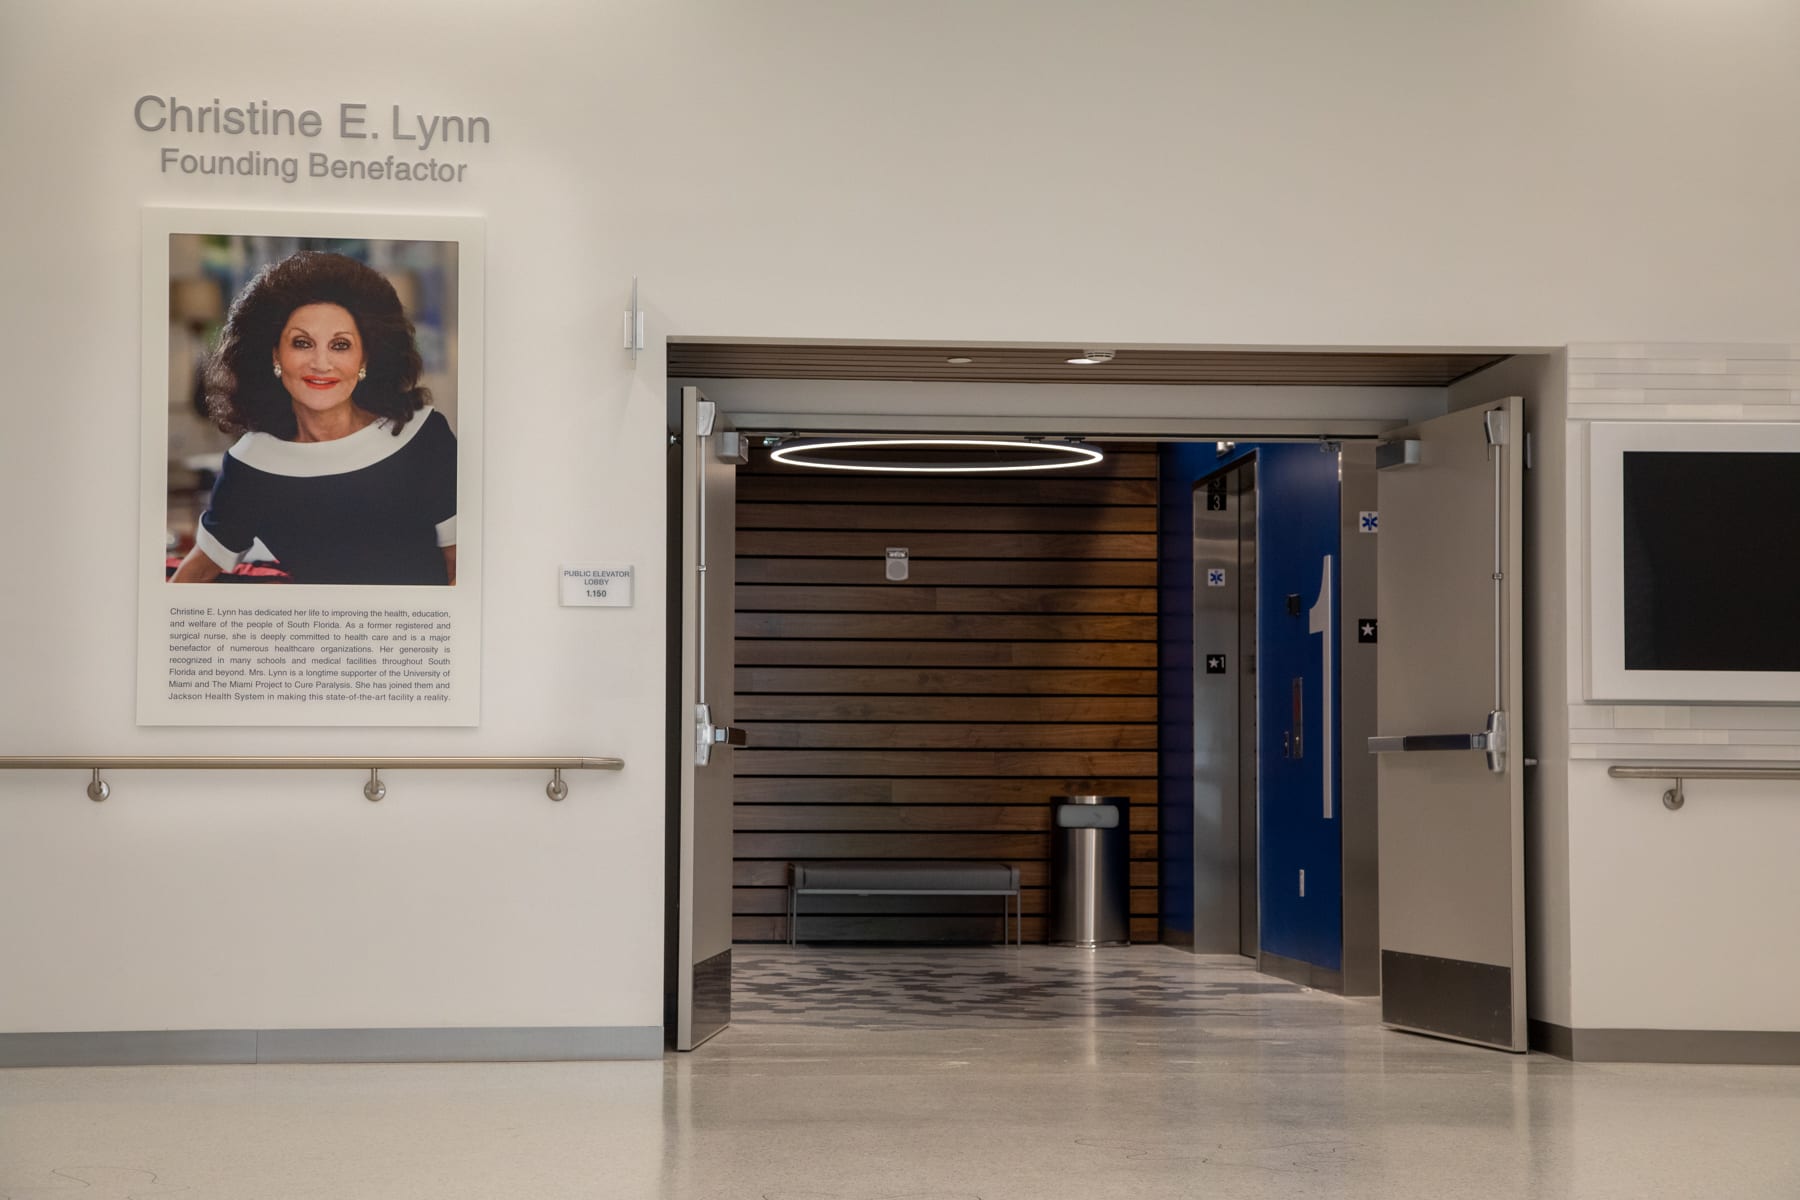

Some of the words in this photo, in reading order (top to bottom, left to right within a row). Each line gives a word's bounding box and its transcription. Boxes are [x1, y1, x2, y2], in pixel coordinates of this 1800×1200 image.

[133, 94, 323, 138] Christine
[339, 102, 379, 140] E.
[392, 104, 490, 152] Lynn
[160, 147, 299, 184] Founding
[308, 151, 468, 183] Benefactor
[170, 608, 205, 616] Christine
[207, 608, 215, 616] E.
[217, 608, 236, 619] Lynn
[238, 608, 253, 617] has
[254, 608, 292, 617] dedicated
[294, 608, 307, 617] her
[309, 609, 320, 617] life
[321, 609, 329, 617] to
[331, 609, 368, 620] improving
[370, 609, 382, 618] the
[384, 609, 410, 618] health,
[412, 609, 451, 619] education,
[170, 620, 185, 628] and
[188, 620, 216, 628] welfare
[220, 620, 227, 629] of
[231, 620, 243, 629] the
[247, 620, 273, 631] people
[276, 620, 284, 629] of
[287, 620, 310, 629] South
[313, 621, 342, 629] Florida.
[345, 621, 356, 629] As
[367, 621, 392, 630] former
[396, 621, 433, 632] registered
[436, 621, 451, 630] and
[170, 632, 199, 642] surgical
[232, 632, 246, 640] she
[251, 632, 256, 641] is
[261, 632, 285, 643] deeply
[290, 632, 329, 641] committed
[334, 632, 340, 641] to
[345, 632, 367, 641] health
[393, 633, 406, 641] and
[411, 633, 416, 641] is
[430, 633, 450, 644] major
[170, 644, 211, 652] benefactor
[217, 644, 224, 652] of
[275, 644, 314, 653] healthcare
[321, 644, 374, 655] organizations.
[380, 644, 393, 653] Her
[399, 645, 438, 655] generosity
[444, 645, 451, 653] is
[169, 655, 212, 666] recognized
[218, 656, 224, 664] in
[230, 658, 252, 667] many
[257, 656, 286, 664] schools
[291, 656, 306, 665] and
[312, 656, 341, 665] medical
[346, 656, 377, 665] facilities
[382, 656, 423, 667] throughout
[428, 657, 450, 665] South
[169, 667, 196, 676] Florida
[198, 668, 213, 676] and
[215, 668, 246, 678] beyond.
[249, 668, 265, 676] Mrs.
[268, 668, 287, 679] Lynn
[290, 668, 296, 676] is
[306, 668, 338, 679] longtime
[341, 668, 377, 679] supporter
[379, 668, 387, 677] of
[389, 668, 401, 677] the
[403, 668, 440, 679] University
[443, 668, 450, 677] of
[169, 680, 192, 688] Miami
[195, 680, 209, 688] and
[212, 680, 227, 688] The
[230, 680, 252, 688] Miami
[256, 680, 282, 691] Project
[285, 680, 292, 688] to
[295, 680, 313, 688] Cure
[316, 680, 353, 691] Paralysis.
[355, 680, 370, 689] She
[373, 680, 386, 689] has
[389, 680, 412, 691] joined
[415, 680, 433, 689] them
[436, 680, 450, 689] and
[1309, 554, 1332, 819] 1
[168, 692, 202, 700] Jackson
[205, 692, 231, 700] Health
[235, 692, 264, 703] System
[267, 692, 274, 701] in
[277, 692, 306, 703] making
[309, 692, 323, 701] this
[326, 692, 385, 701] state-of-the-art
[388, 692, 414, 703] facility
[424, 692, 450, 703] reality.
